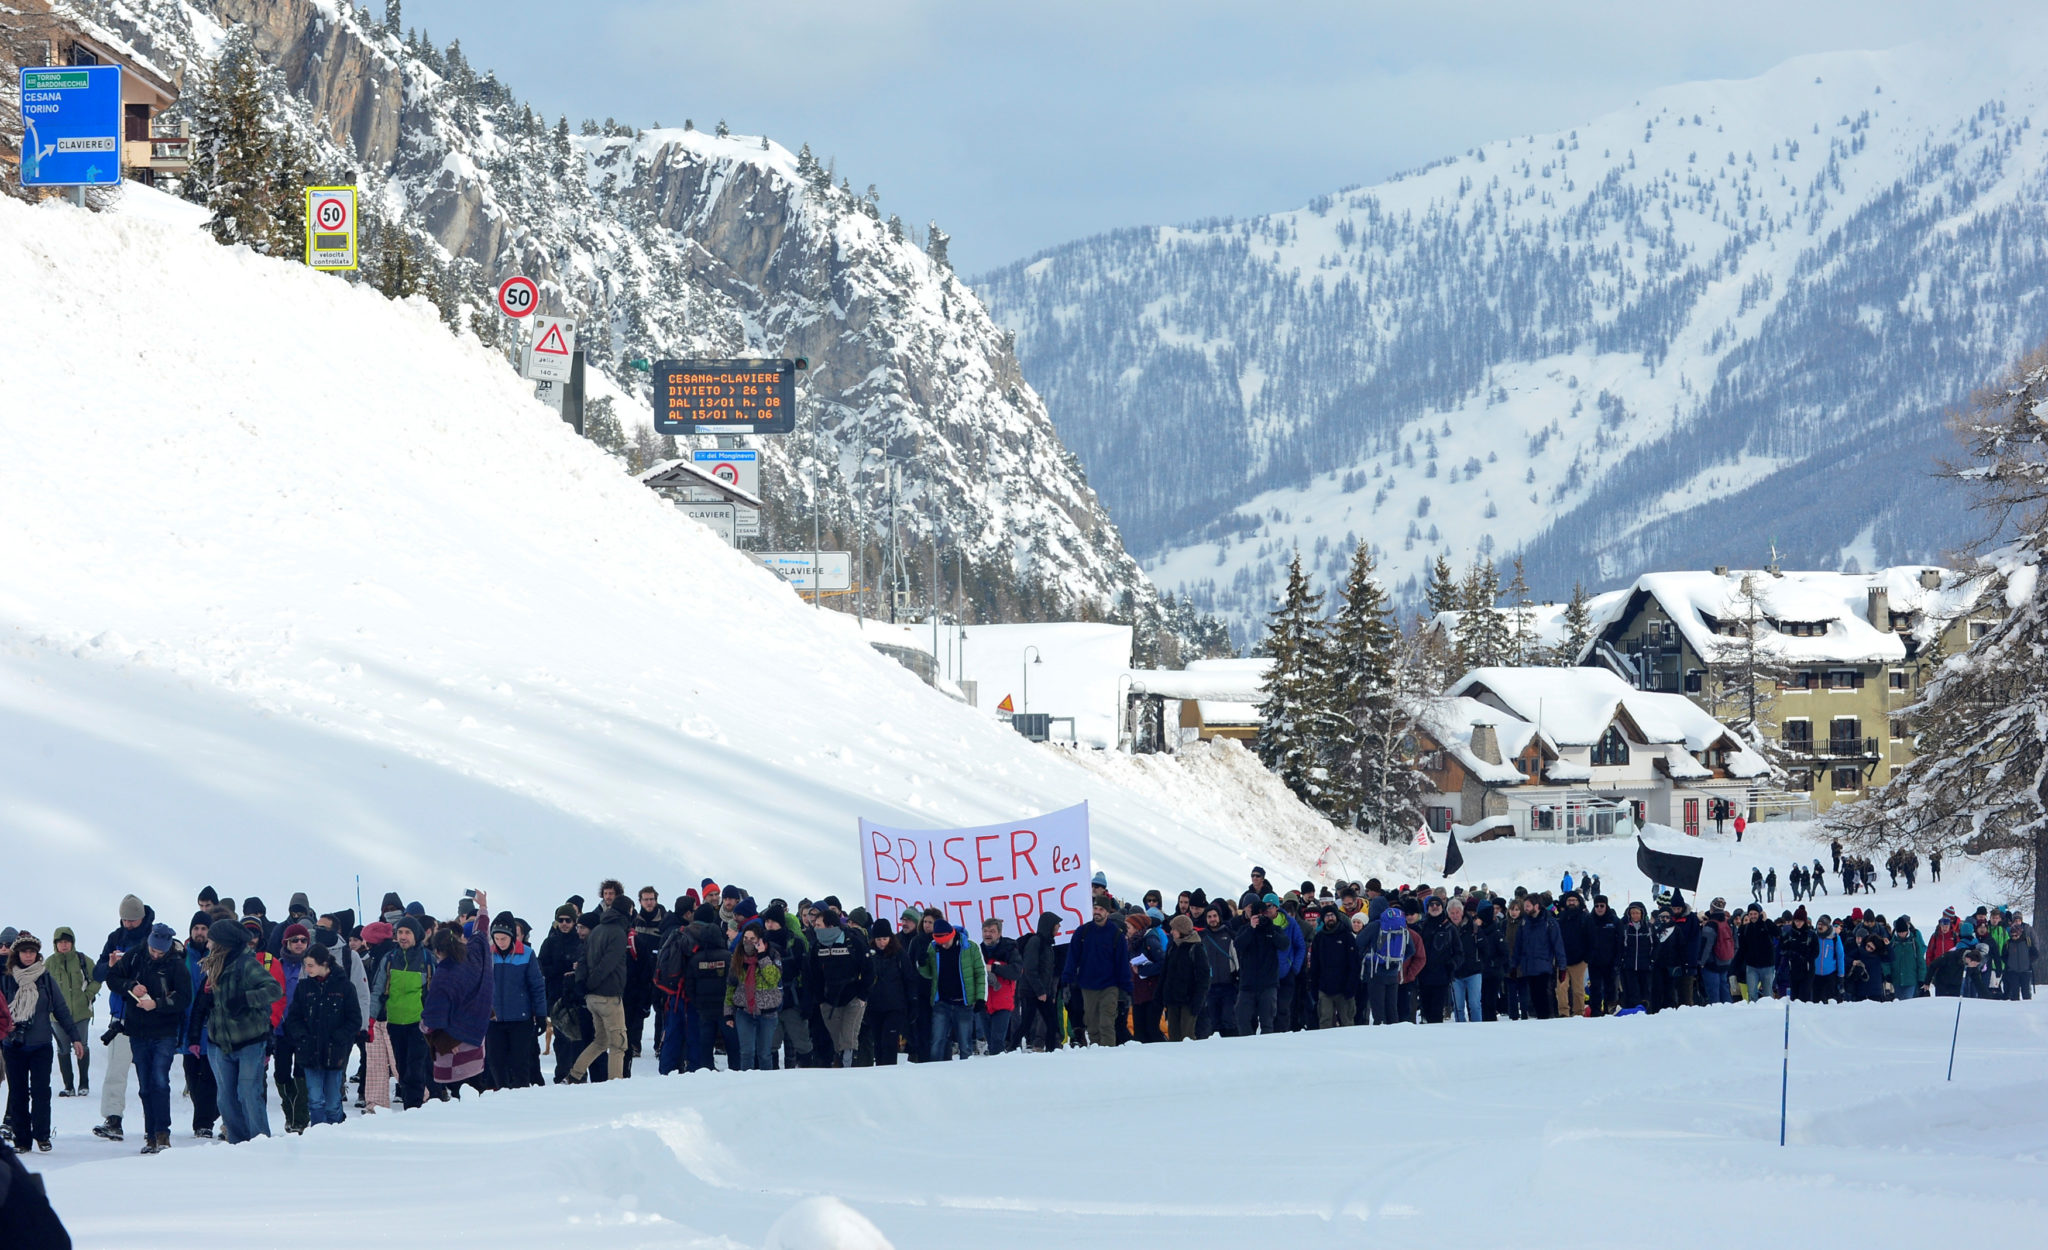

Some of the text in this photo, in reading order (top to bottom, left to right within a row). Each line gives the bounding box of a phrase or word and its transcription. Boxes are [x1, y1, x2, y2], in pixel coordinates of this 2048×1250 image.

[24, 92, 62, 101] CESANA
[24, 104, 60, 113] TORINO
[58, 140, 103, 149] CLAVIERE
[322, 207, 340, 222] 50
[506, 288, 531, 306] 50
[668, 373, 780, 384] CESANA-CLAVIERE
[669, 386, 721, 396] DIVIETO
[743, 386, 758, 395] 26
[765, 386, 773, 395] t
[669, 398, 780, 408] DAL 13/01 h. 08
[668, 410, 773, 420] AL 15/01 h. 06
[688, 511, 730, 519] CLAVIERE
[872, 830, 1081, 887] BRISER les
